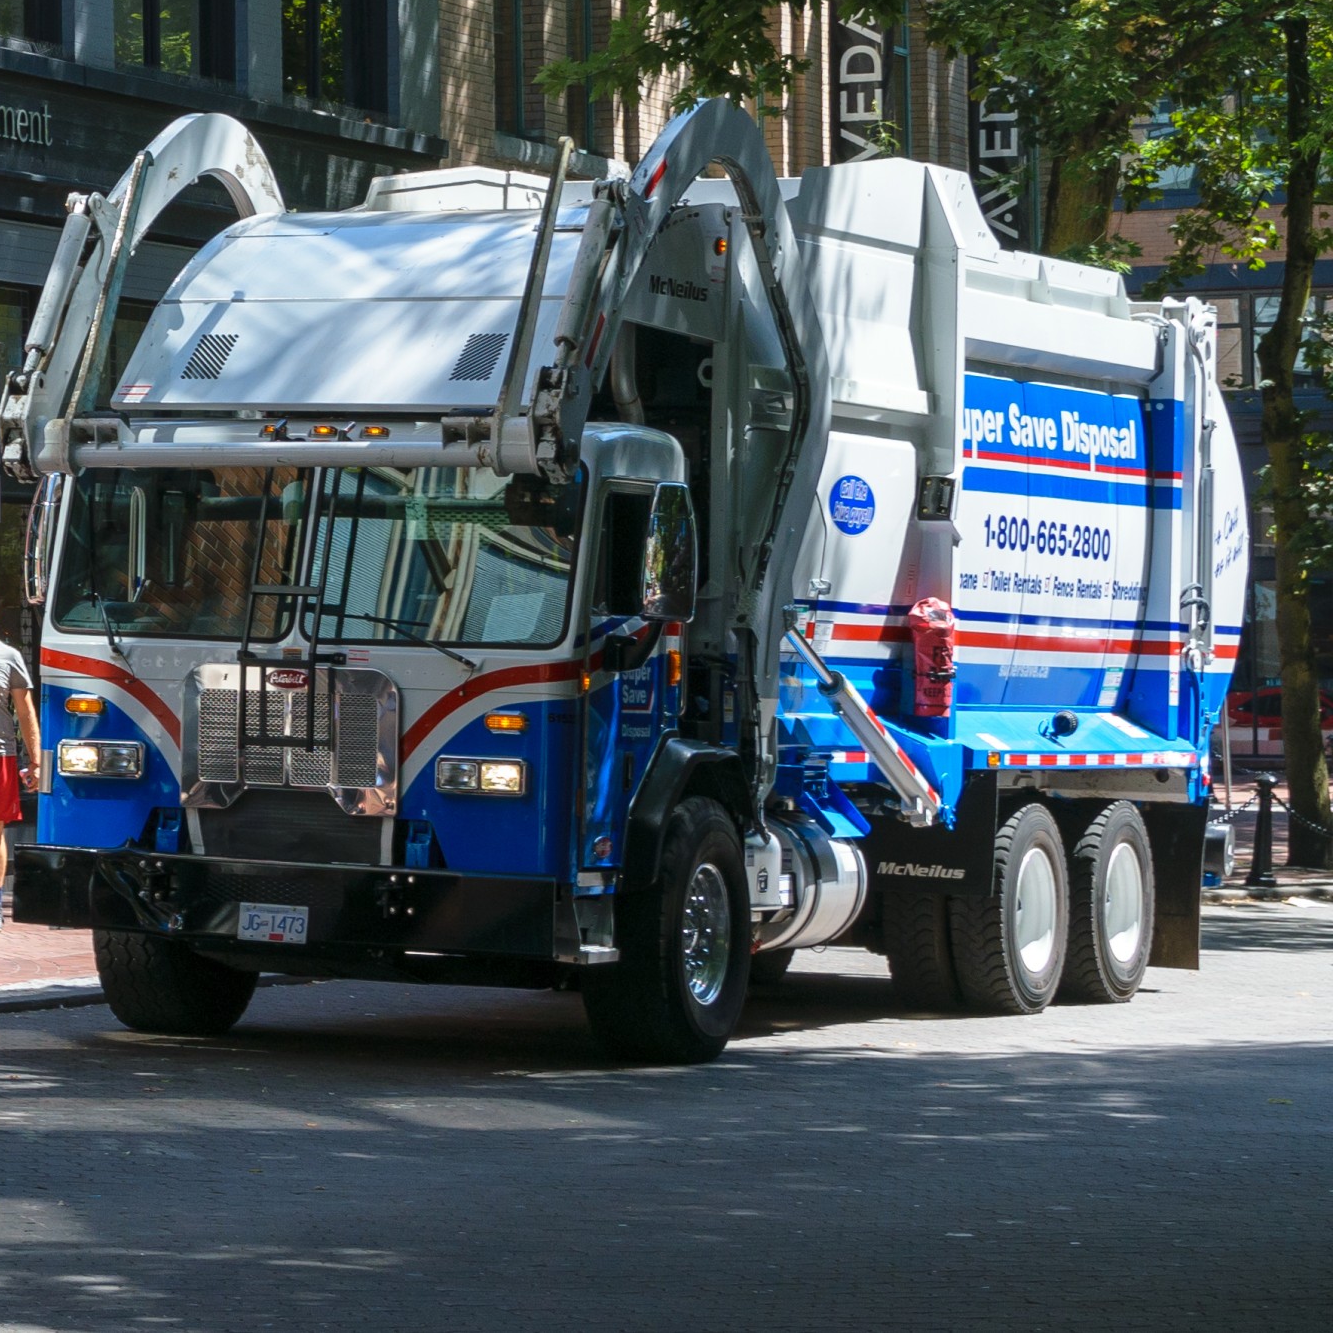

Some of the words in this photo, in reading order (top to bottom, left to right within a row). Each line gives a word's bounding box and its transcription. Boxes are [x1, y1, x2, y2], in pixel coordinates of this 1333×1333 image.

[839, 7, 883, 163] VEDA
[649, 274, 708, 302] McNeilus
[962, 408, 1005, 459] uper
[1008, 402, 1058, 451] Save
[1060, 410, 1137, 472] Disposal
[984, 513, 1111, 562] 1-800-665-2800
[991, 570, 1011, 592] Toilet
[1013, 572, 1042, 595] Rentals
[1053, 576, 1074, 598] Fence
[1076, 578, 1102, 599] Rentals
[622, 684, 647, 704] Save
[876, 861, 966, 880] McNeilus
